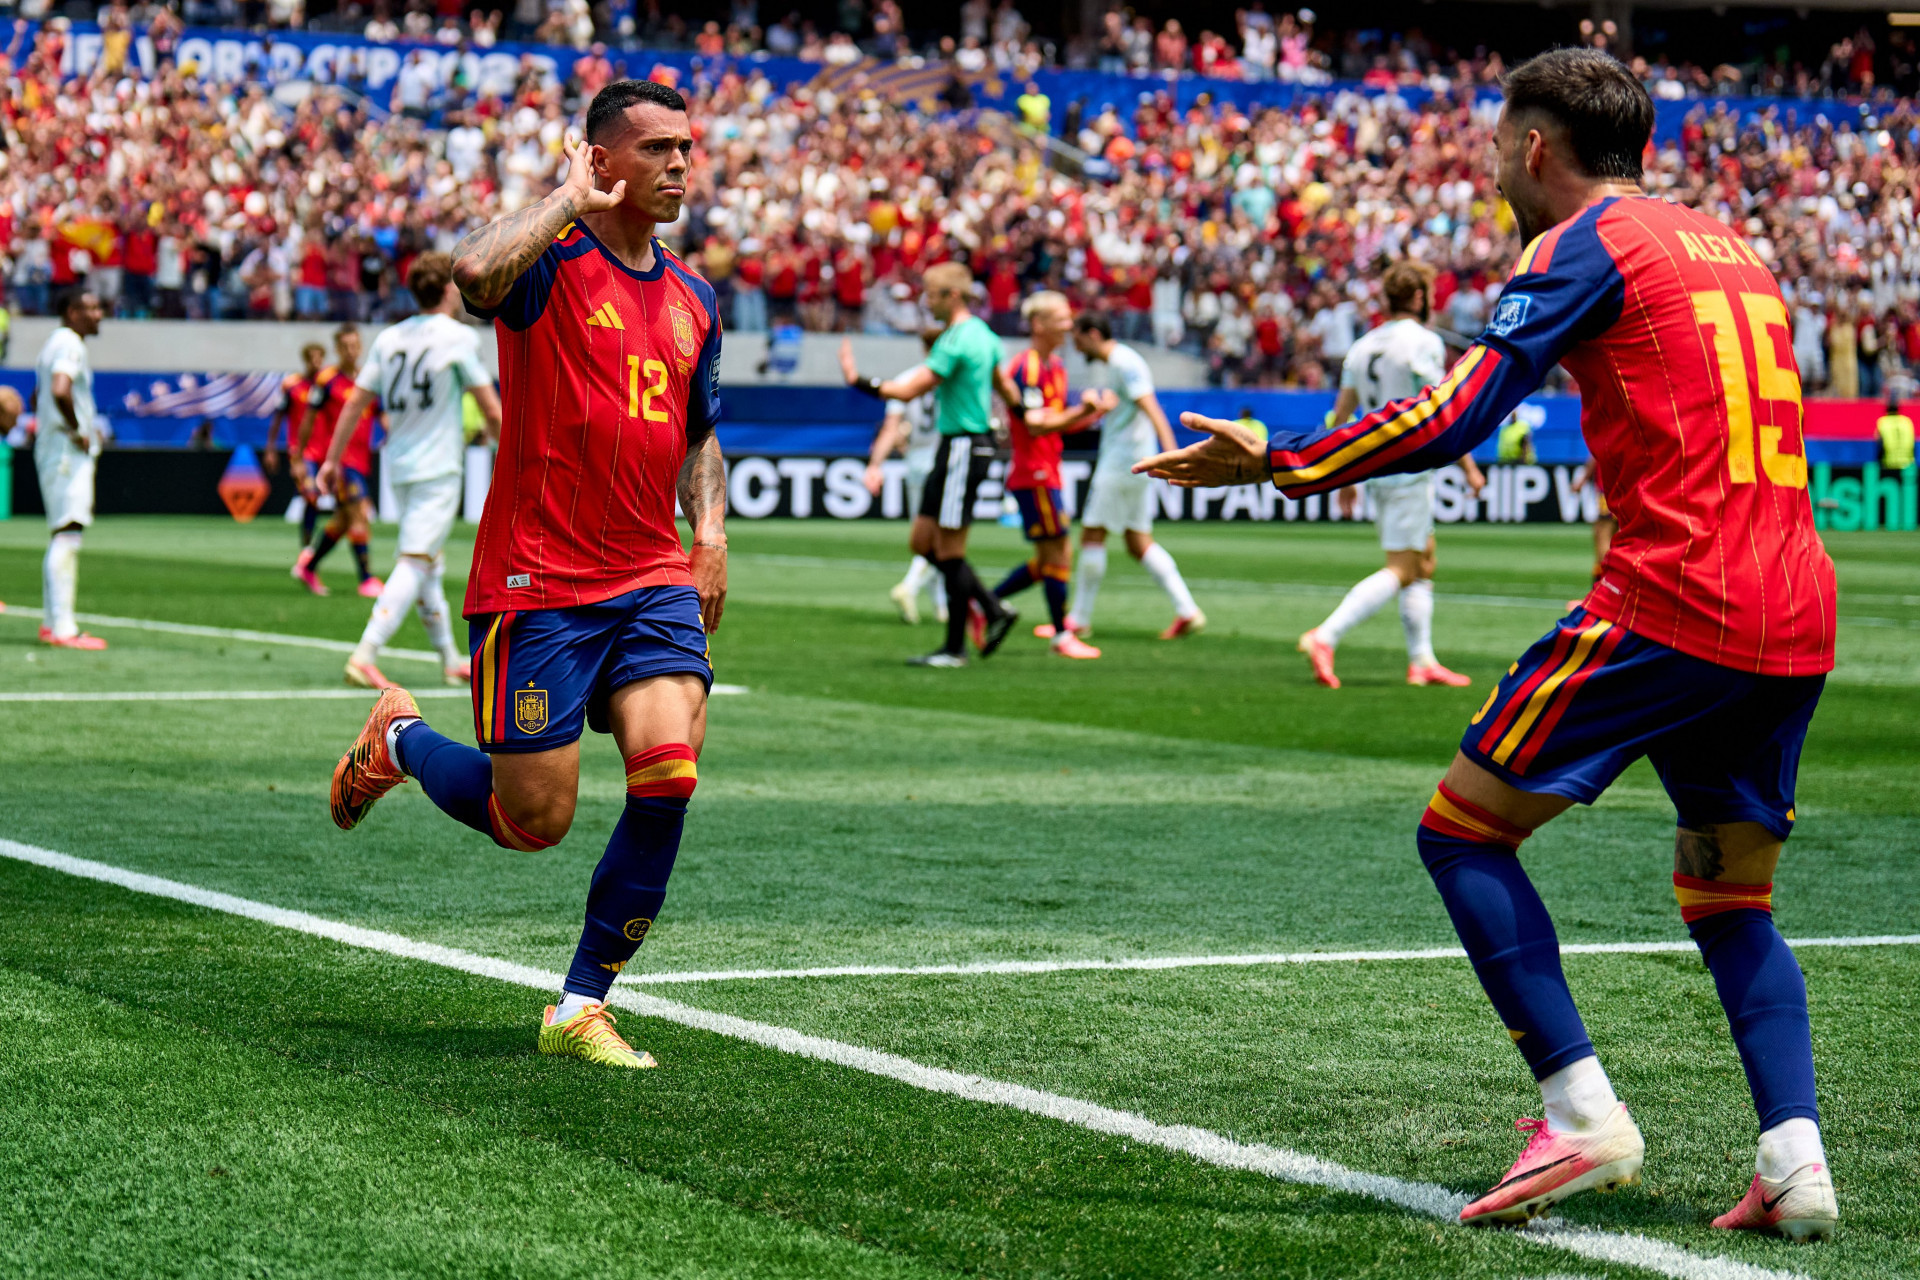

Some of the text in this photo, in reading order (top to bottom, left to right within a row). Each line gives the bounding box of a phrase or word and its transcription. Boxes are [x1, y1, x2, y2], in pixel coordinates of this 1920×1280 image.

[1676, 230, 1762, 267] ALEX B
[388, 346, 433, 411] 24
[627, 354, 668, 423] 12
[1690, 290, 1807, 489] 15
[1807, 461, 1918, 531] lshi
